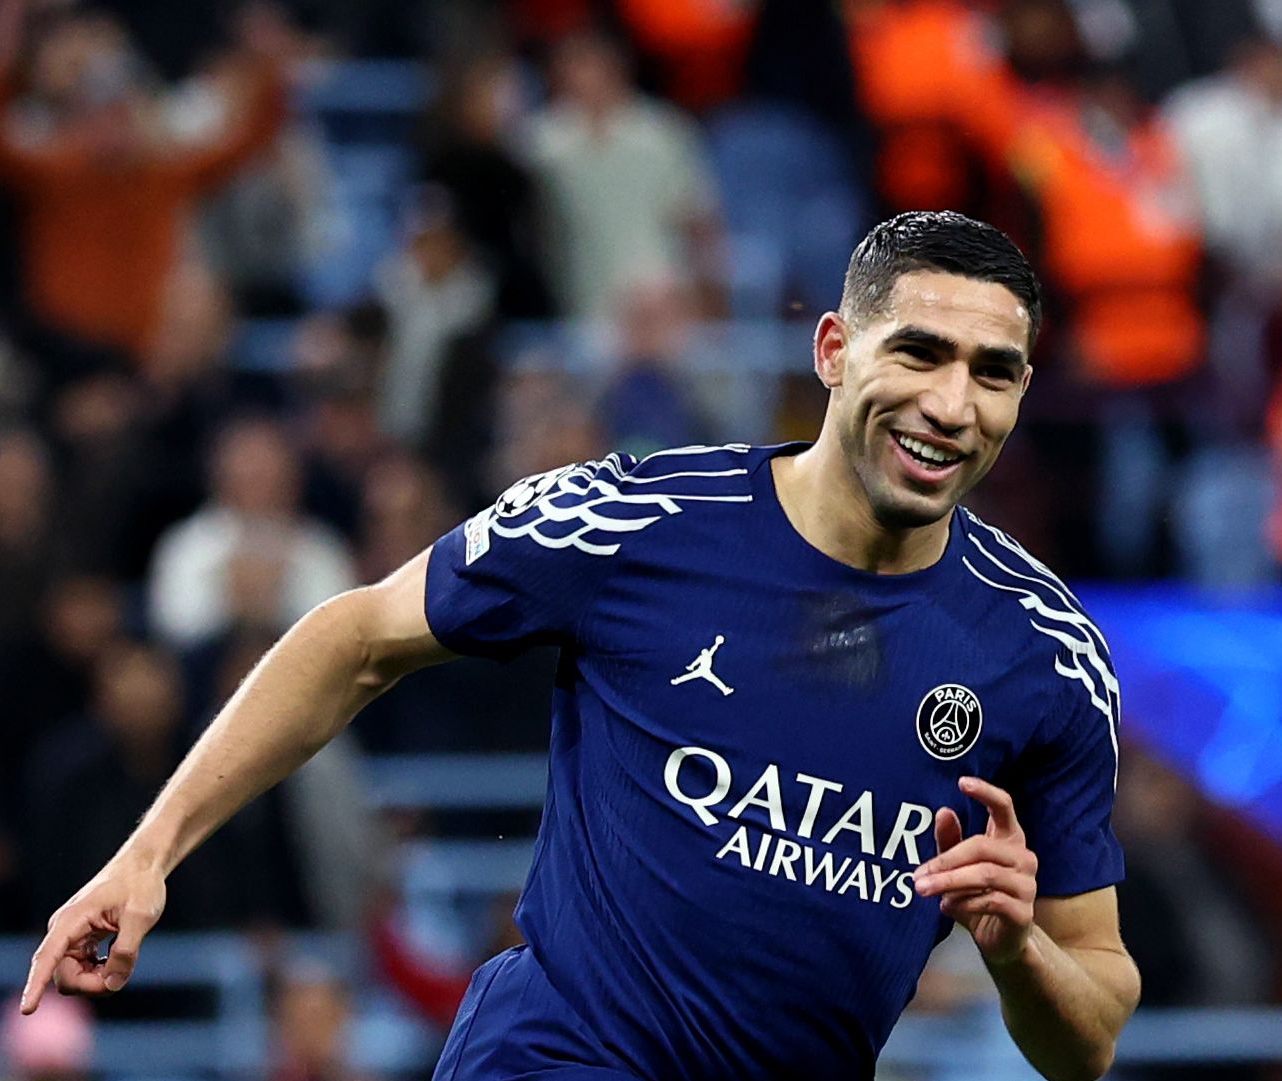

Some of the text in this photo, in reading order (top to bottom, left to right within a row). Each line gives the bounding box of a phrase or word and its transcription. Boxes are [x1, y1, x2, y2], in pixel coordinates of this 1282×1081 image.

[934, 687, 977, 713] PARIS
[663, 746, 933, 866] QATAR
[716, 824, 915, 910] AIRWAYS
